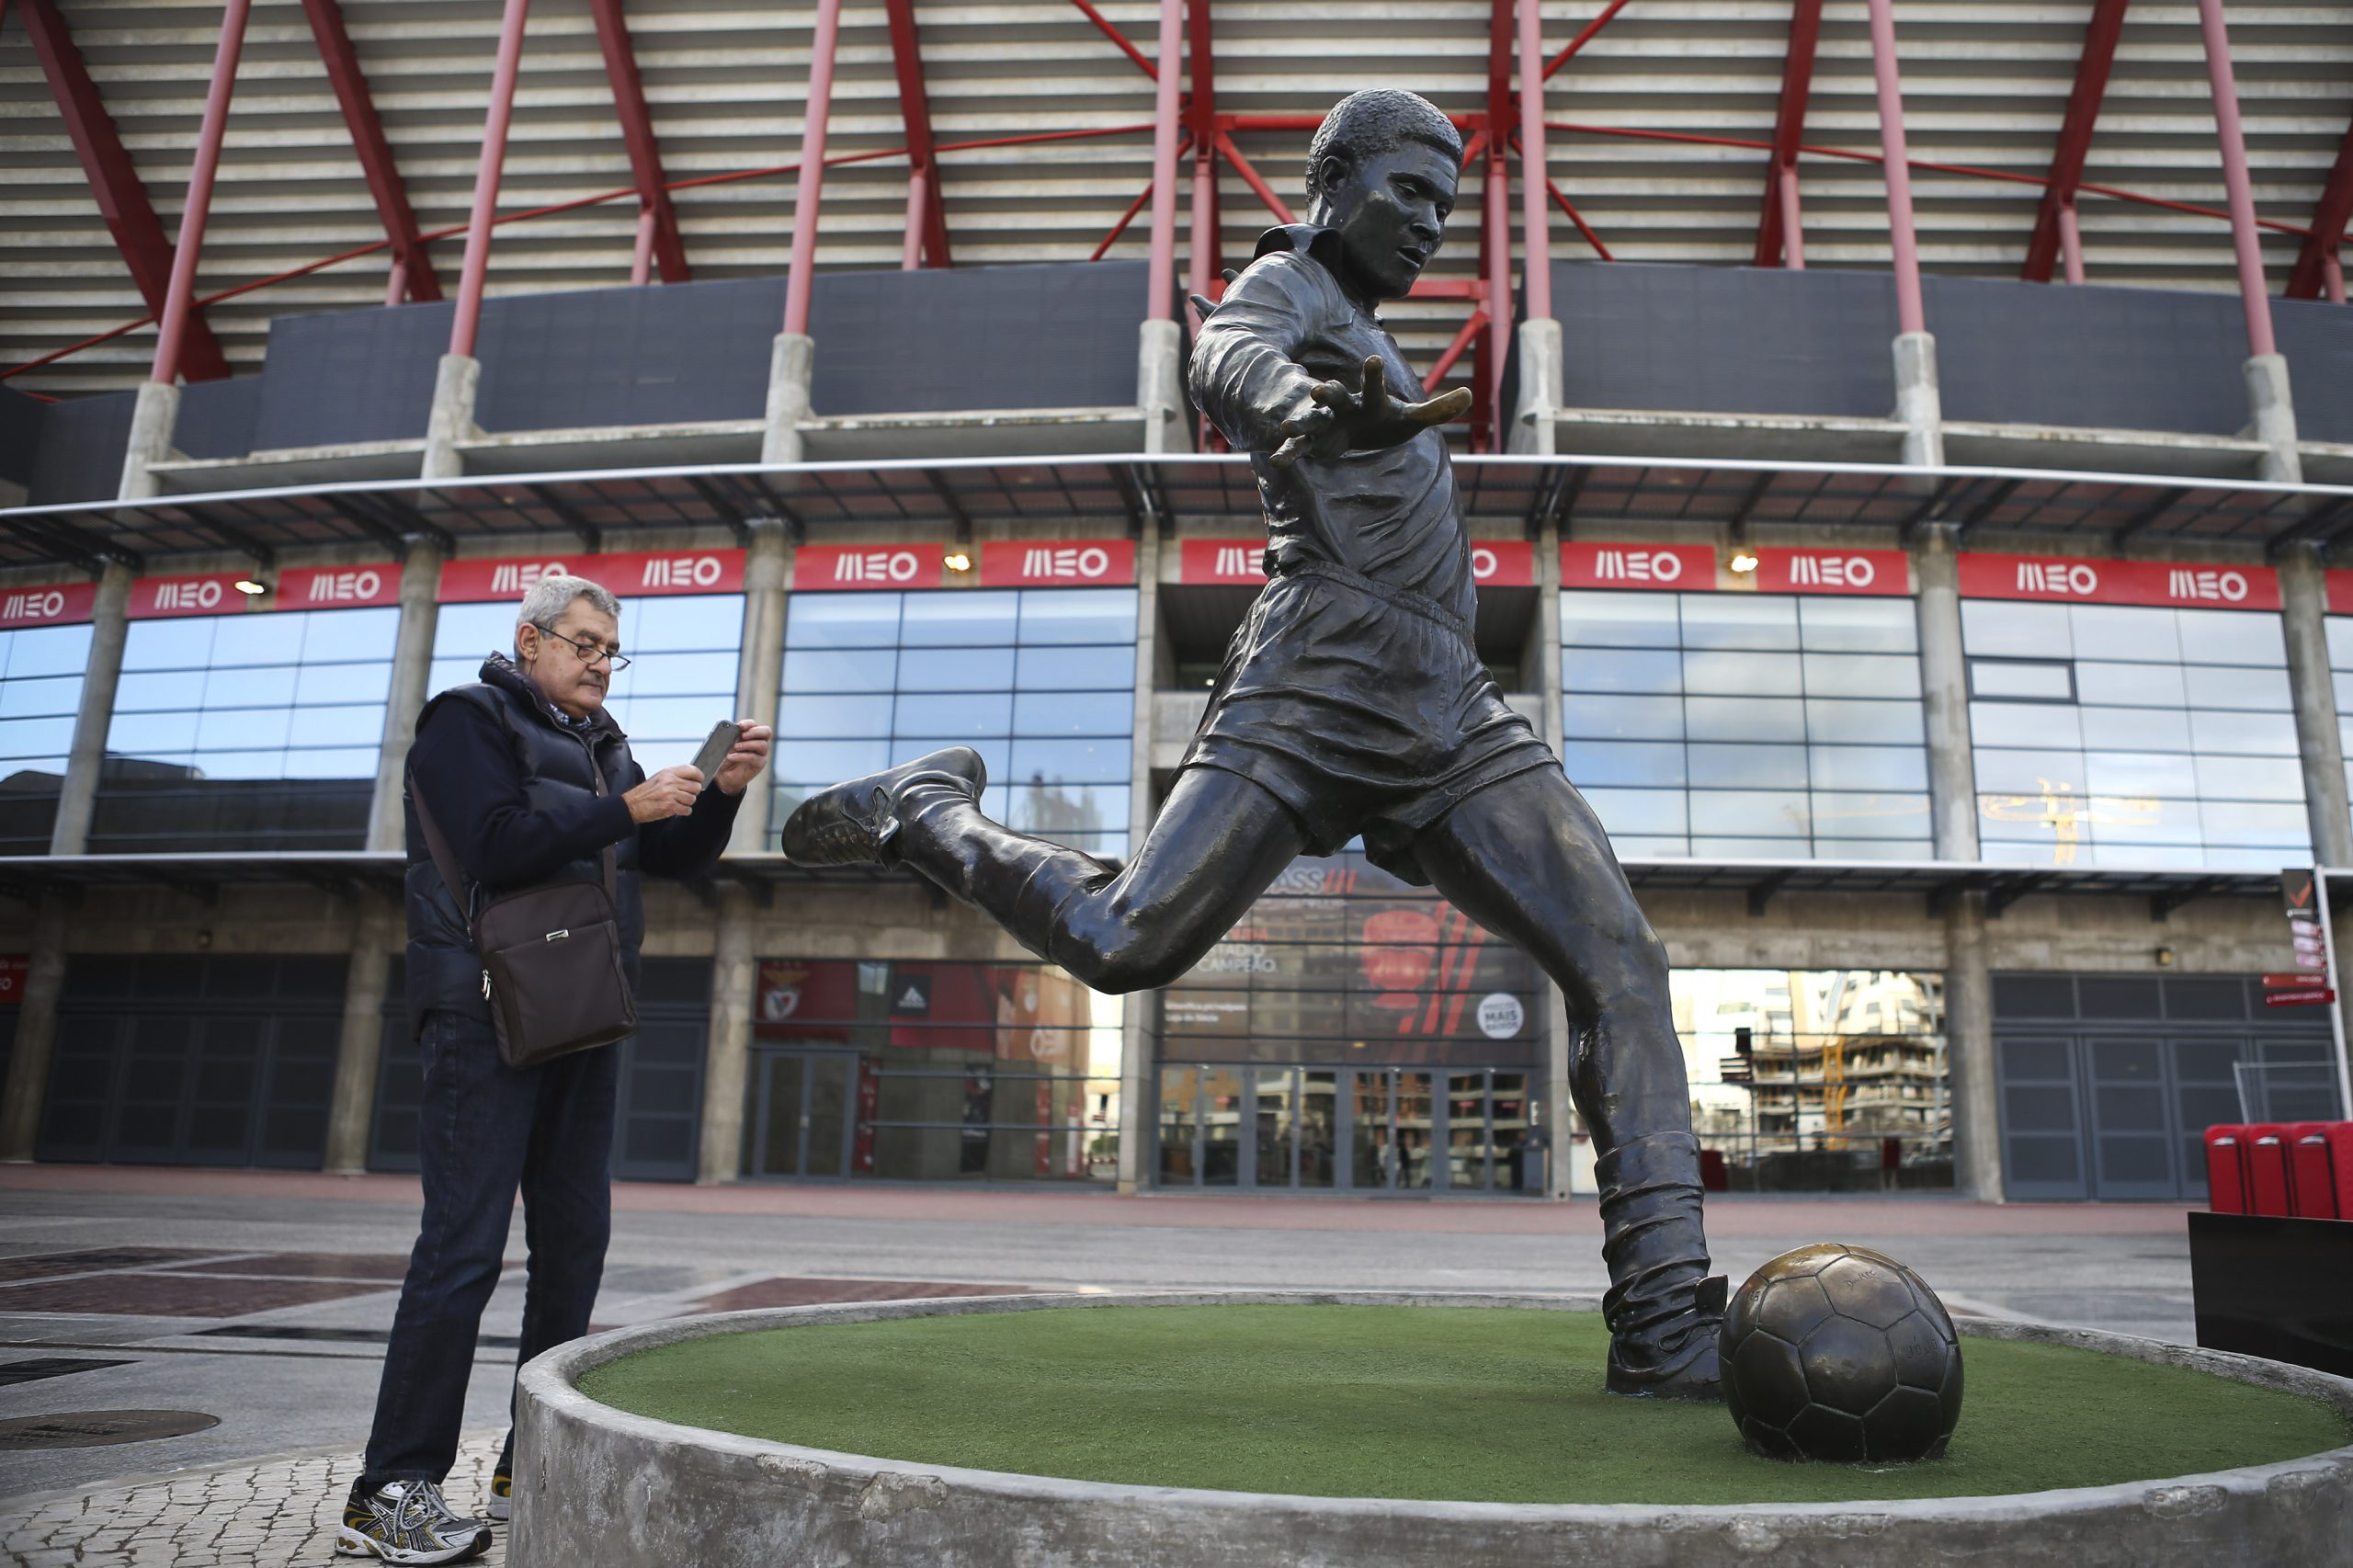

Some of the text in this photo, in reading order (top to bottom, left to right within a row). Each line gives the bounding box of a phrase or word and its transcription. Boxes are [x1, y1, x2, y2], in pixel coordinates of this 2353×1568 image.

[642, 557, 722, 588] MEO
[834, 552, 918, 582] MEO
[1022, 549, 1109, 578] MEO
[1215, 548, 1266, 576] ME
[1595, 551, 1682, 582] MEO
[1790, 556, 1875, 585] MEO
[154, 579, 222, 610] MEO
[308, 570, 381, 602] MEO
[2017, 563, 2098, 596] MEO
[2169, 571, 2248, 602] MEO
[4, 591, 64, 619] MEO
[1484, 1011, 1518, 1022] MAIS
